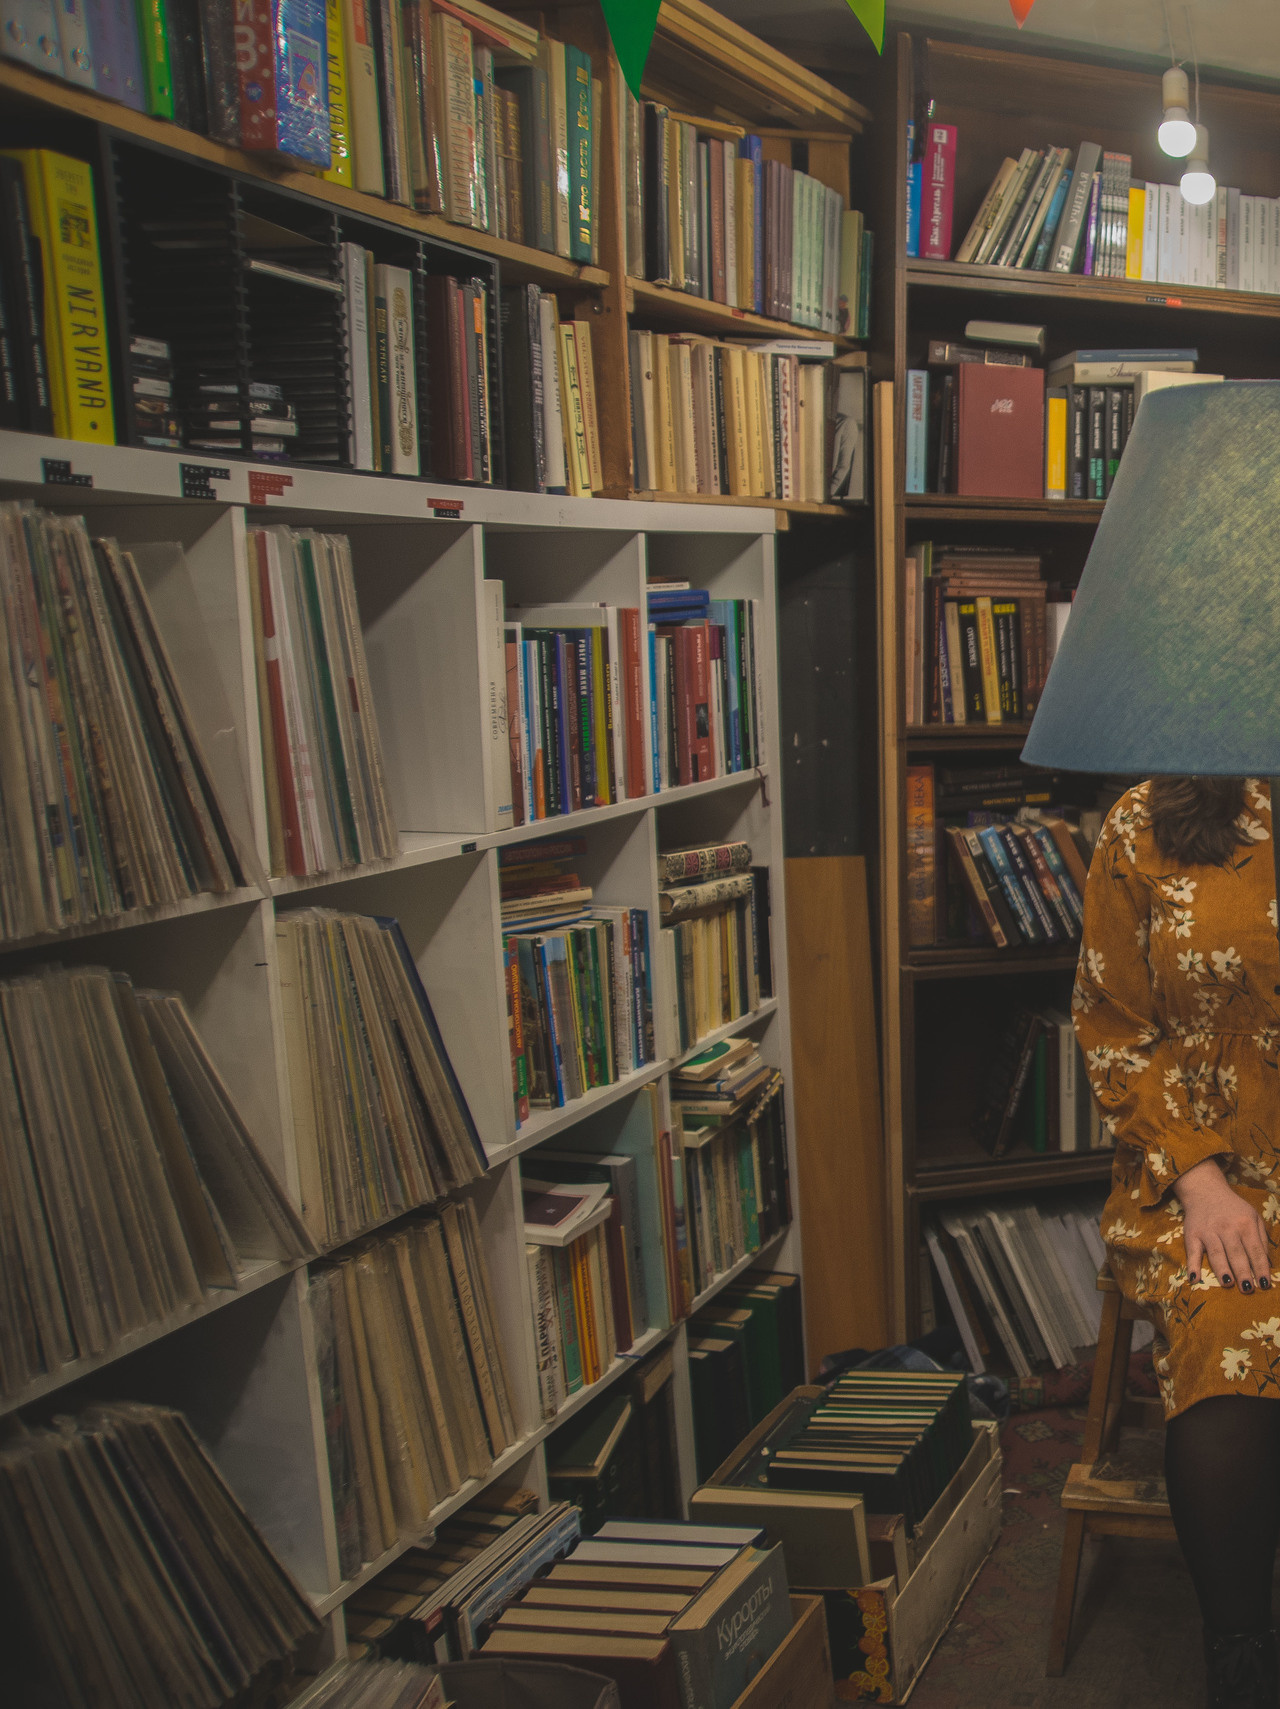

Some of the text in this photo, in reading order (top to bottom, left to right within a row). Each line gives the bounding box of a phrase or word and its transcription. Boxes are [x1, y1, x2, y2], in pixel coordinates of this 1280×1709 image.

[327, 52, 348, 156] NIRVANA
[1070, 171, 1089, 224] УЧИТЕЛЯ
[66, 285, 106, 409] NIRVANA
[378, 338, 387, 383] МУЗЫКА
[578, 639, 586, 667] РОБЕРТ
[490, 681, 498, 740] СОВРЕМЕННАЯ
[914, 775, 924, 807] ВЕКА
[510, 963, 519, 993] ИНДИЮ
[513, 999, 522, 1048] АВТОСТОПОМ
[536, 1311, 551, 1356] ПАРИЖ
[716, 1576, 774, 1650] Курорты
